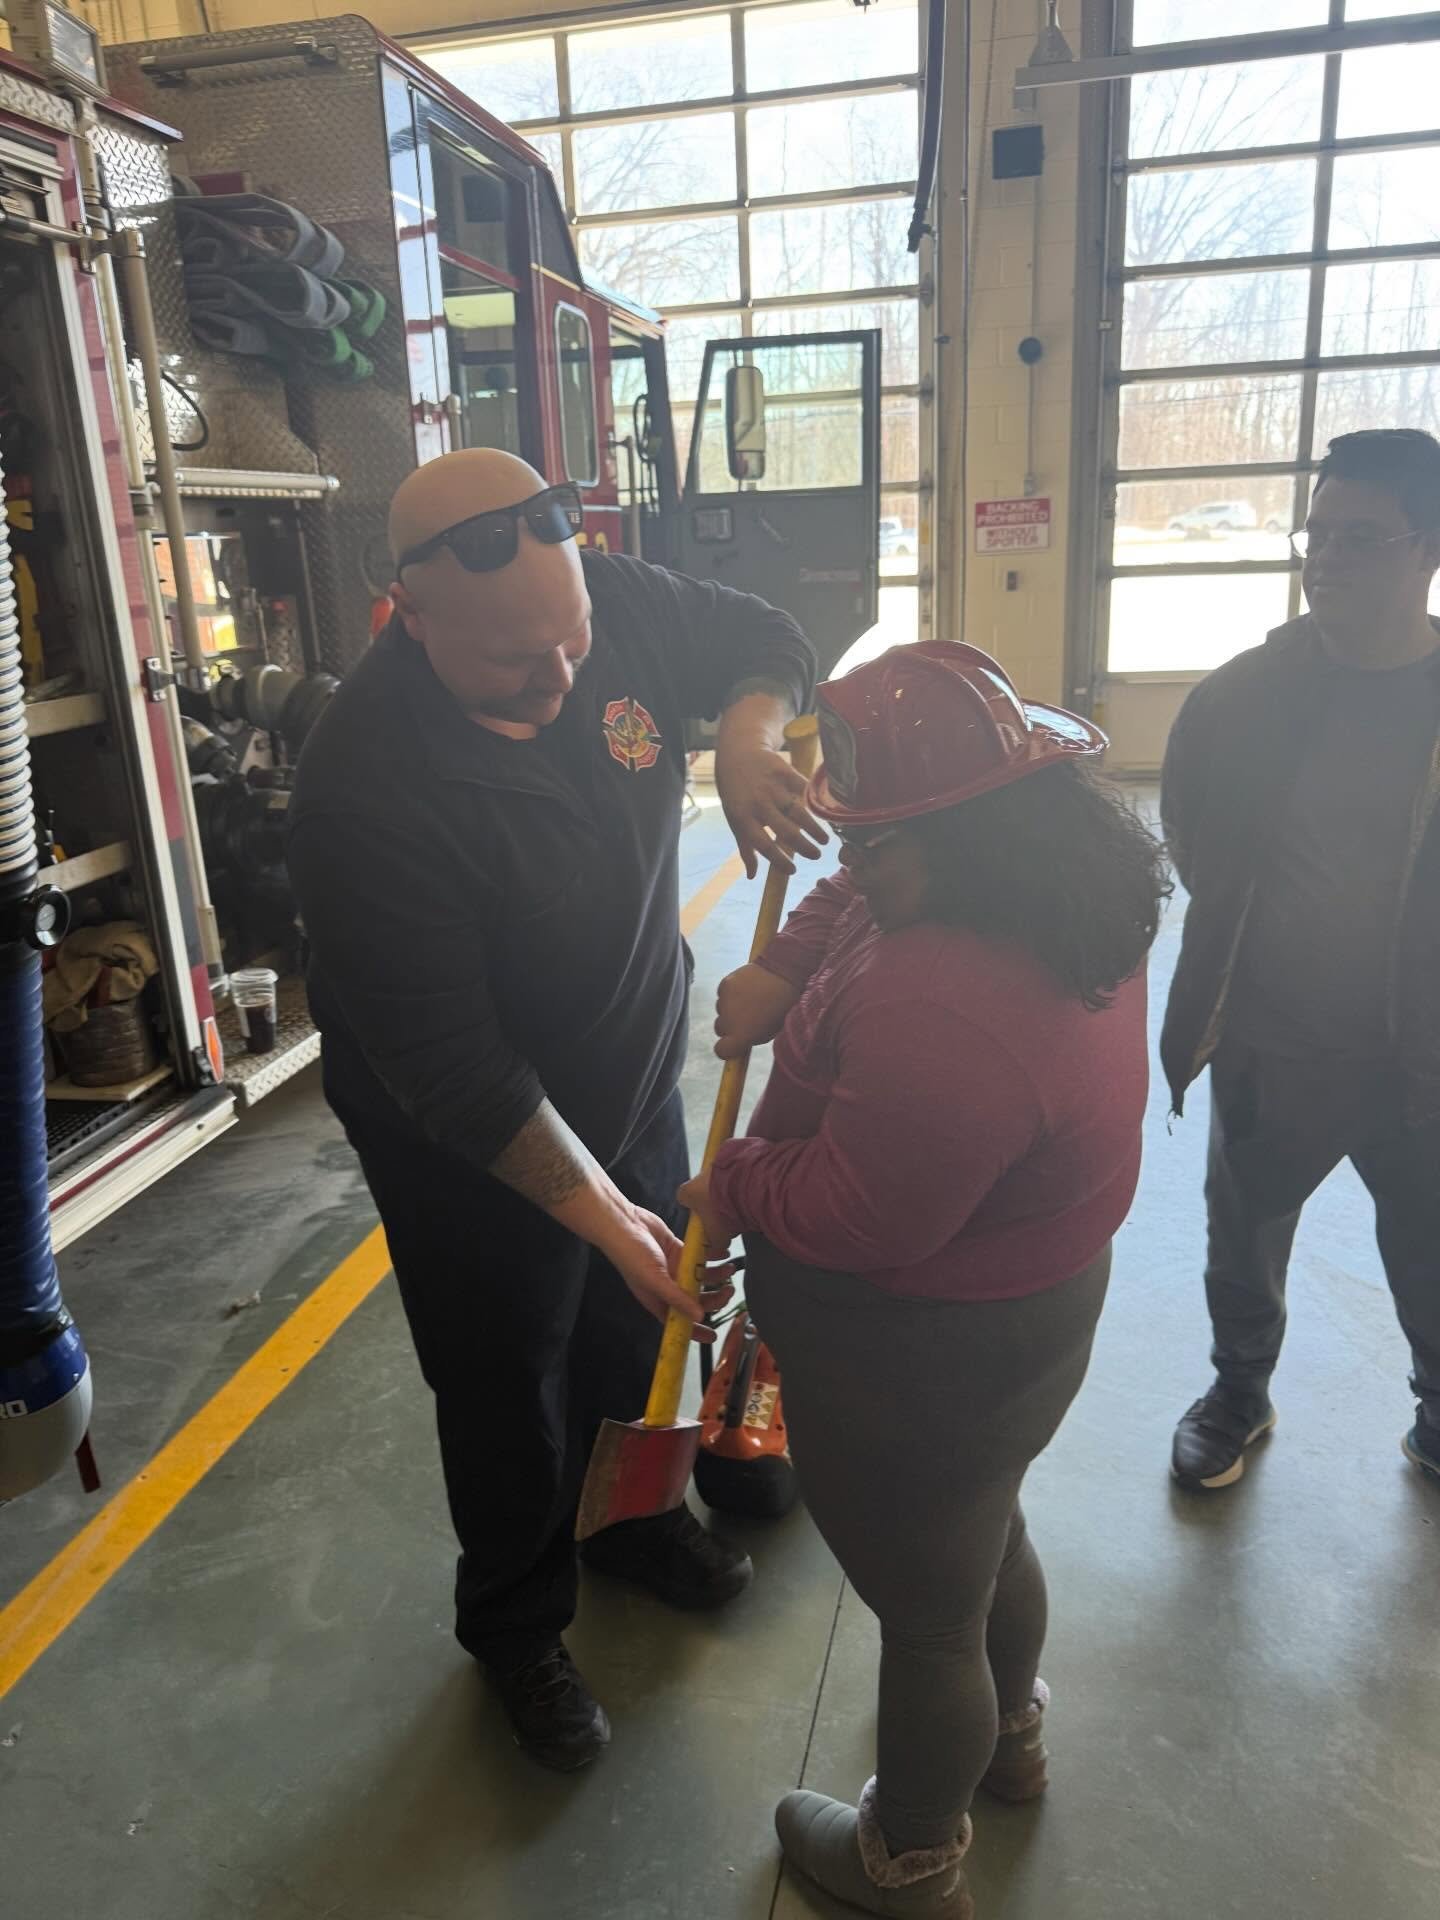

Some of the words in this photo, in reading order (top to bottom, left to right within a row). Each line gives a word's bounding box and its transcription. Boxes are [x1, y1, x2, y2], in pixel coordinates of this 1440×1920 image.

[985, 501, 1040, 515] BACKING
[977, 511, 1048, 526] PROHIBITED
[986, 526, 1038, 538] WITHOUT
[986, 535, 1039, 548] SPOTTER
